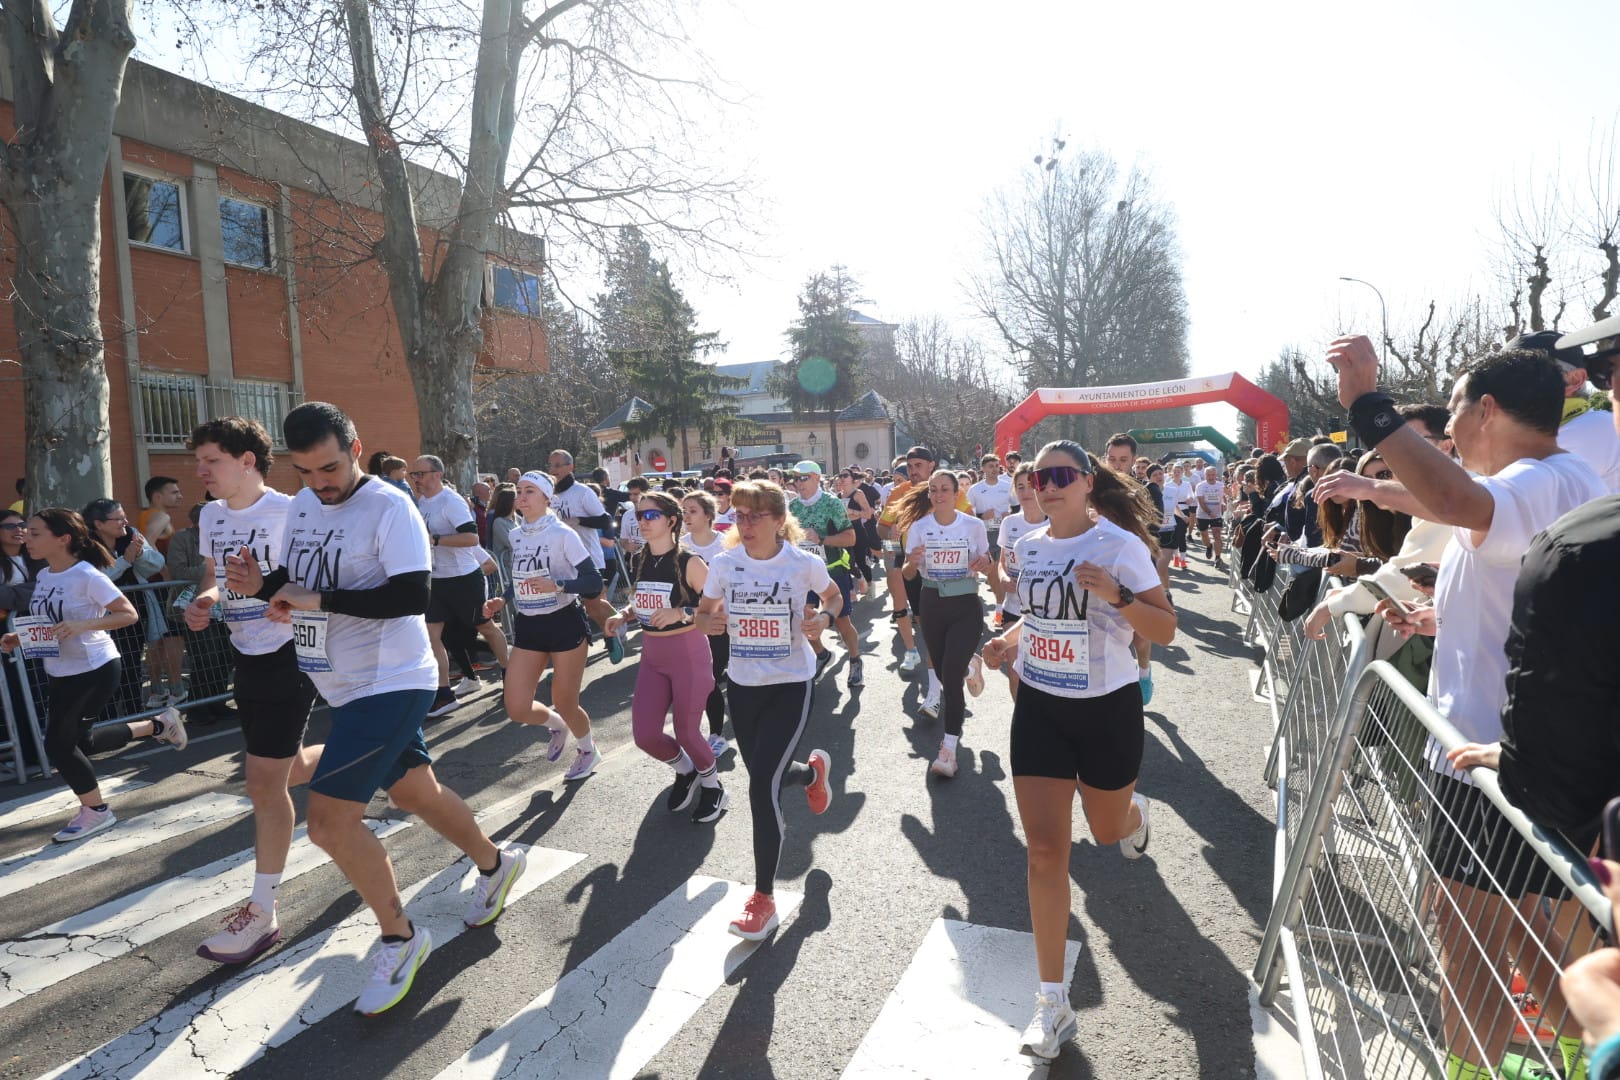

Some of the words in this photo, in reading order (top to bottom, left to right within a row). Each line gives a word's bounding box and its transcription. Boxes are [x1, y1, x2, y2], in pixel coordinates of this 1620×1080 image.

[1079, 389, 1146, 401] AYUNTAMIENTO
[1148, 387, 1160, 396] DE
[1162, 385, 1186, 395] LEÓN
[1174, 429, 1203, 438] RURAL
[933, 551, 961, 564] 3737
[635, 593, 664, 609] 3808
[738, 618, 780, 638] 3896
[1029, 633, 1075, 663] 3894
